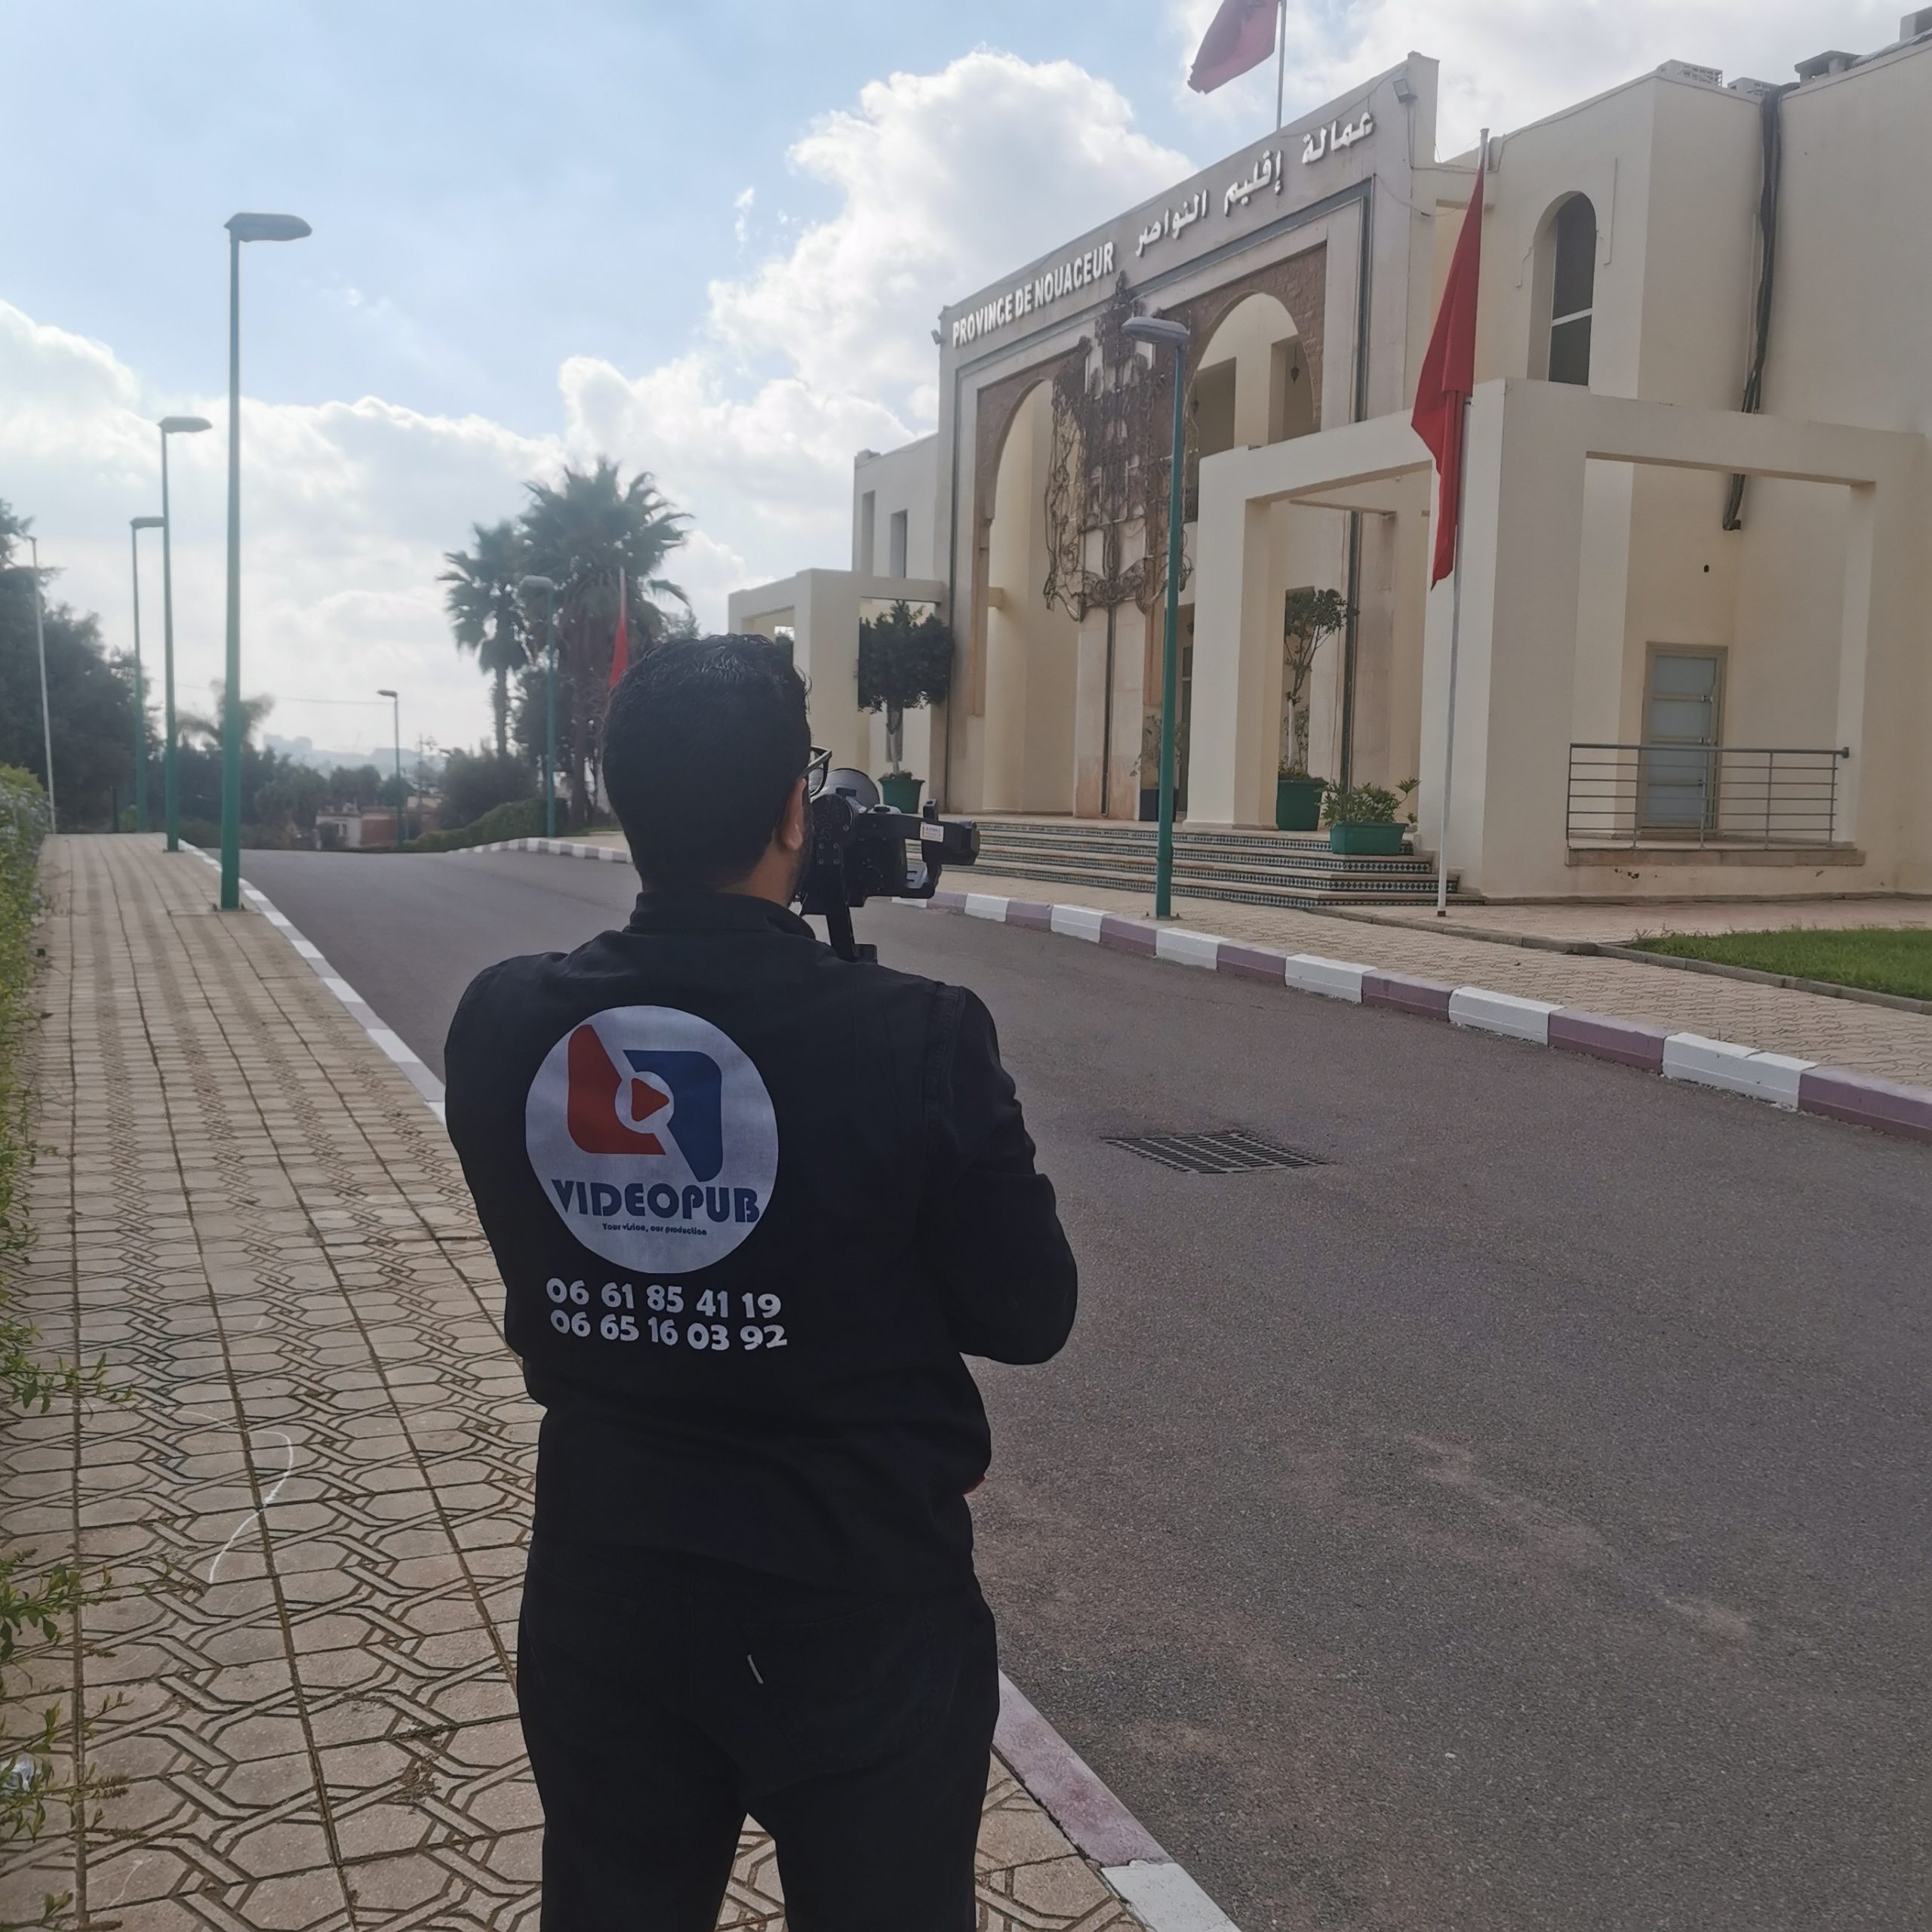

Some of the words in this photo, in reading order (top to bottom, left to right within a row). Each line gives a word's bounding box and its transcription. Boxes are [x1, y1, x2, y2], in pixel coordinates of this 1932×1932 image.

[1302, 112, 1374, 164] عمالة
[1224, 149, 1281, 216] إقليم
[1135, 189, 1208, 257] النواصر
[952, 294, 1013, 348] PROVINCE
[1015, 283, 1033, 318] DE
[1034, 241, 1114, 308] NOUACEUR
[551, 1179, 760, 1223] VIDEOPUB
[602, 1223, 621, 1231] Your
[665, 1226, 707, 1236] production
[546, 1278, 589, 1306] 06
[601, 1282, 634, 1309] 61
[647, 1285, 685, 1313] 85
[696, 1289, 729, 1318] 41
[741, 1291, 782, 1318] 19
[550, 1309, 590, 1338] 06
[600, 1314, 639, 1341] 65
[648, 1316, 678, 1346] 16
[687, 1323, 730, 1351] 03
[740, 1325, 788, 1351] 92
